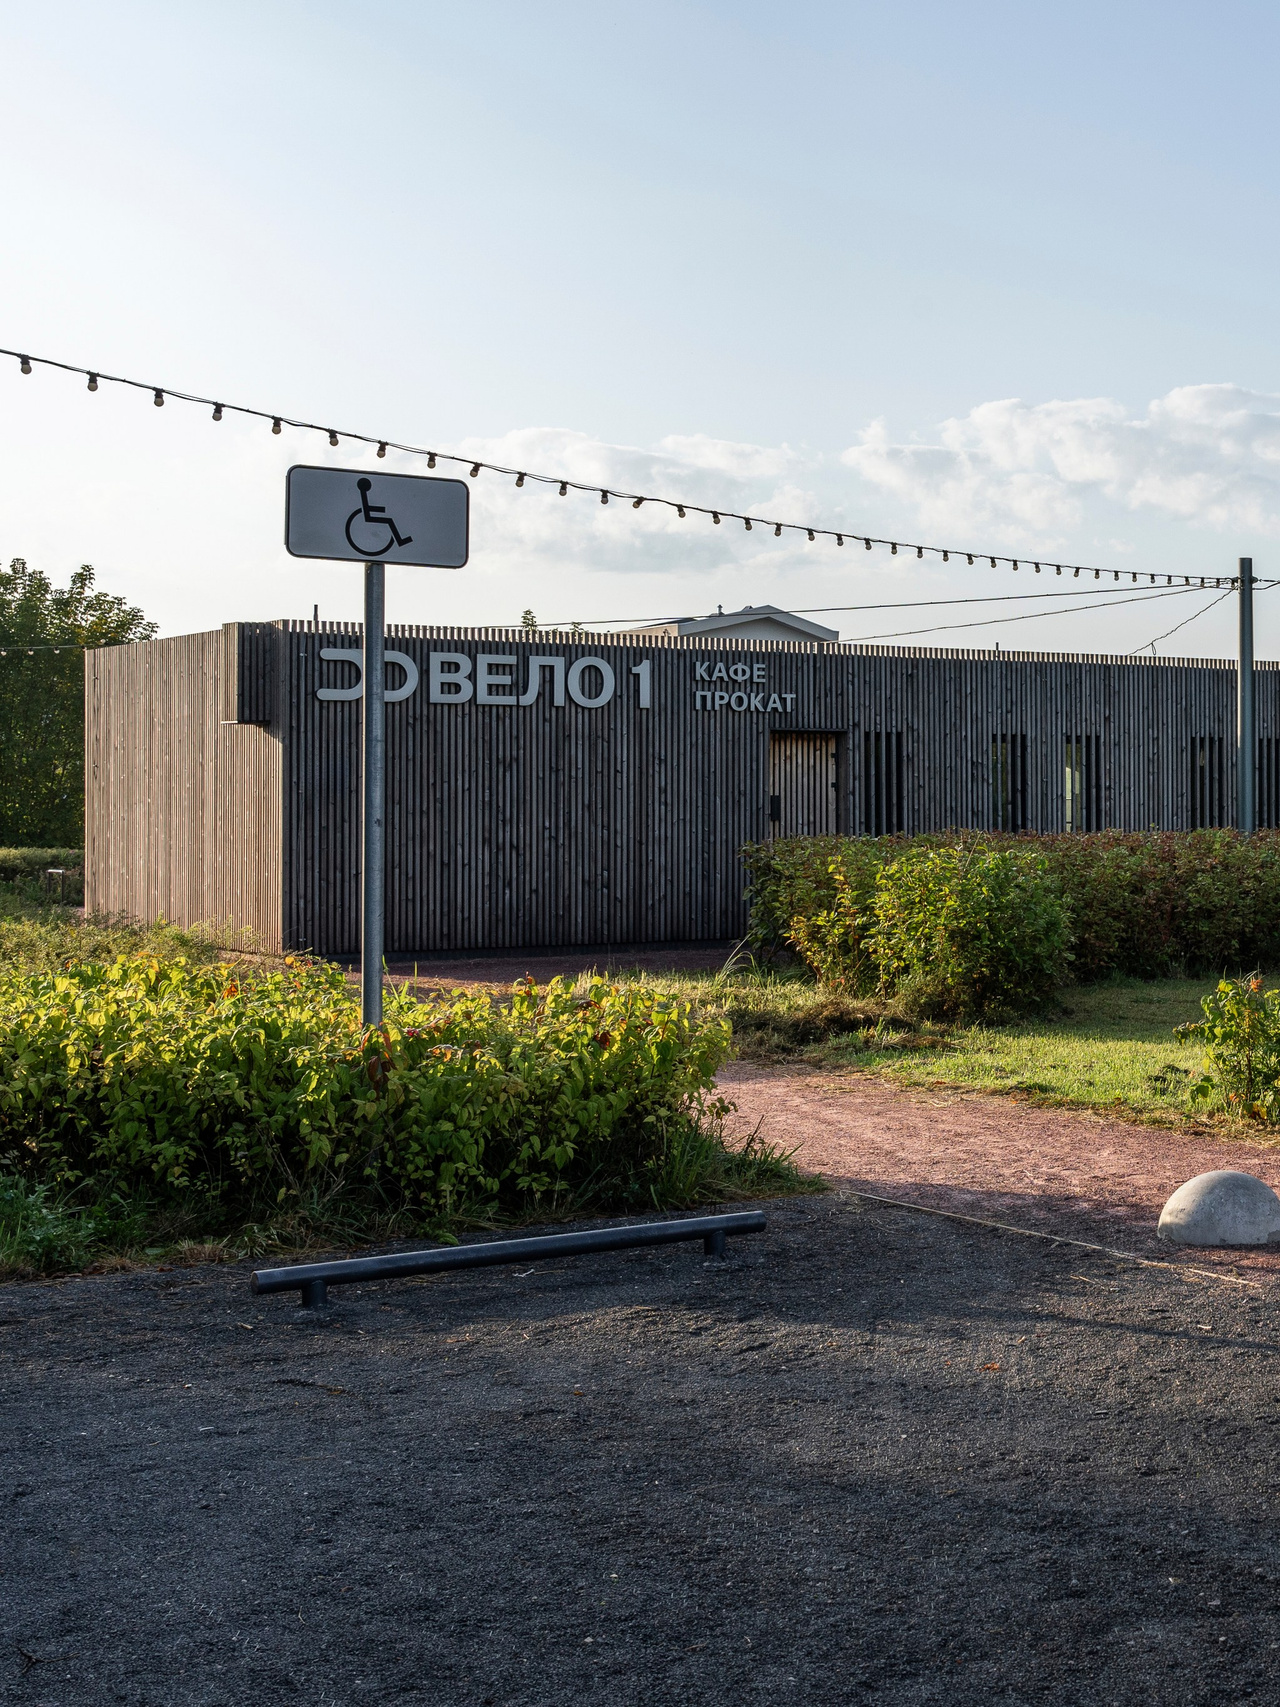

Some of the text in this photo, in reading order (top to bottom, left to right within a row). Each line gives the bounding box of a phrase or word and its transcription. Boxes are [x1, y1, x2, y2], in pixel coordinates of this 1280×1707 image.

[429, 651, 651, 709] ВЕЛО 1
[695, 661, 767, 683] КАФЕ
[695, 690, 797, 713] ПРОКАТ
